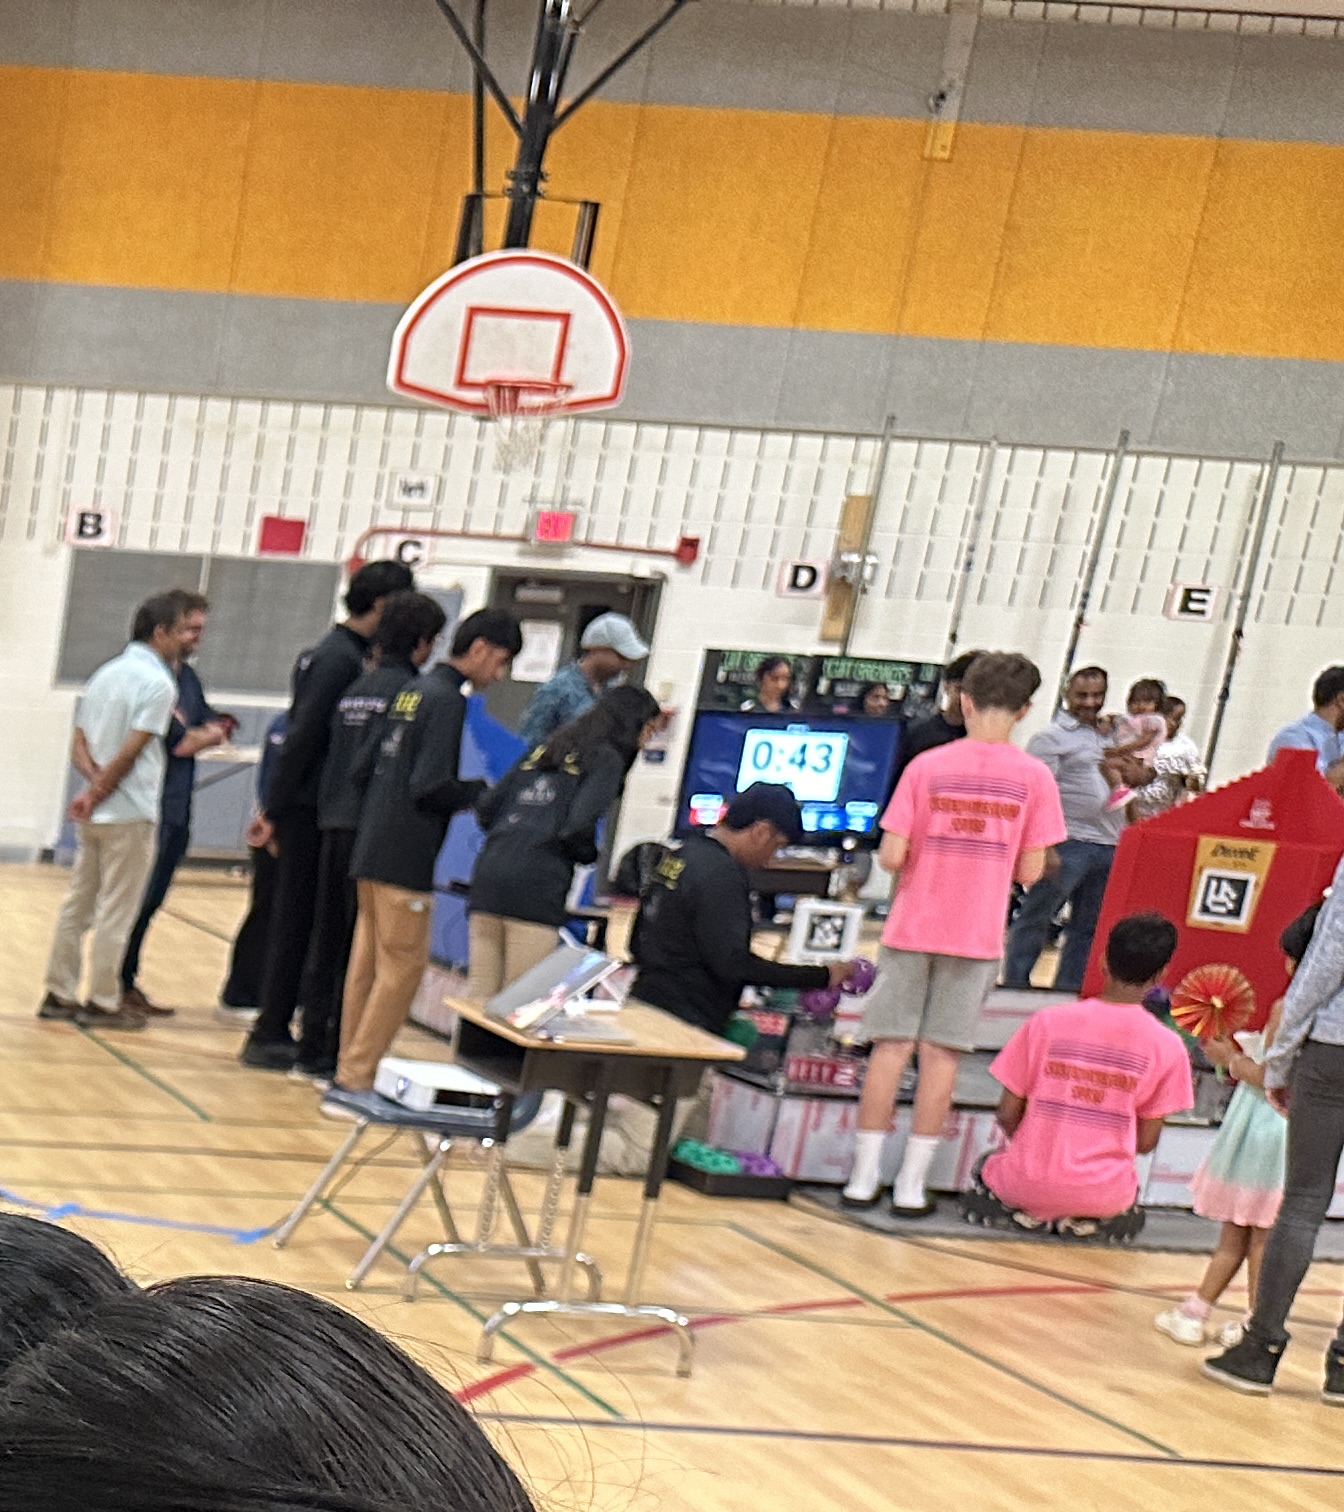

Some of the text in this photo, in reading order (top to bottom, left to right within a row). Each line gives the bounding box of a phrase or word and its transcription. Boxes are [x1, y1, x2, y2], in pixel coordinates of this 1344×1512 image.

[78, 511, 102, 539] B
[398, 540, 422, 565] C
[791, 564, 817, 590] D
[1178, 587, 1212, 616] E
[752, 740, 834, 773] 0:43
